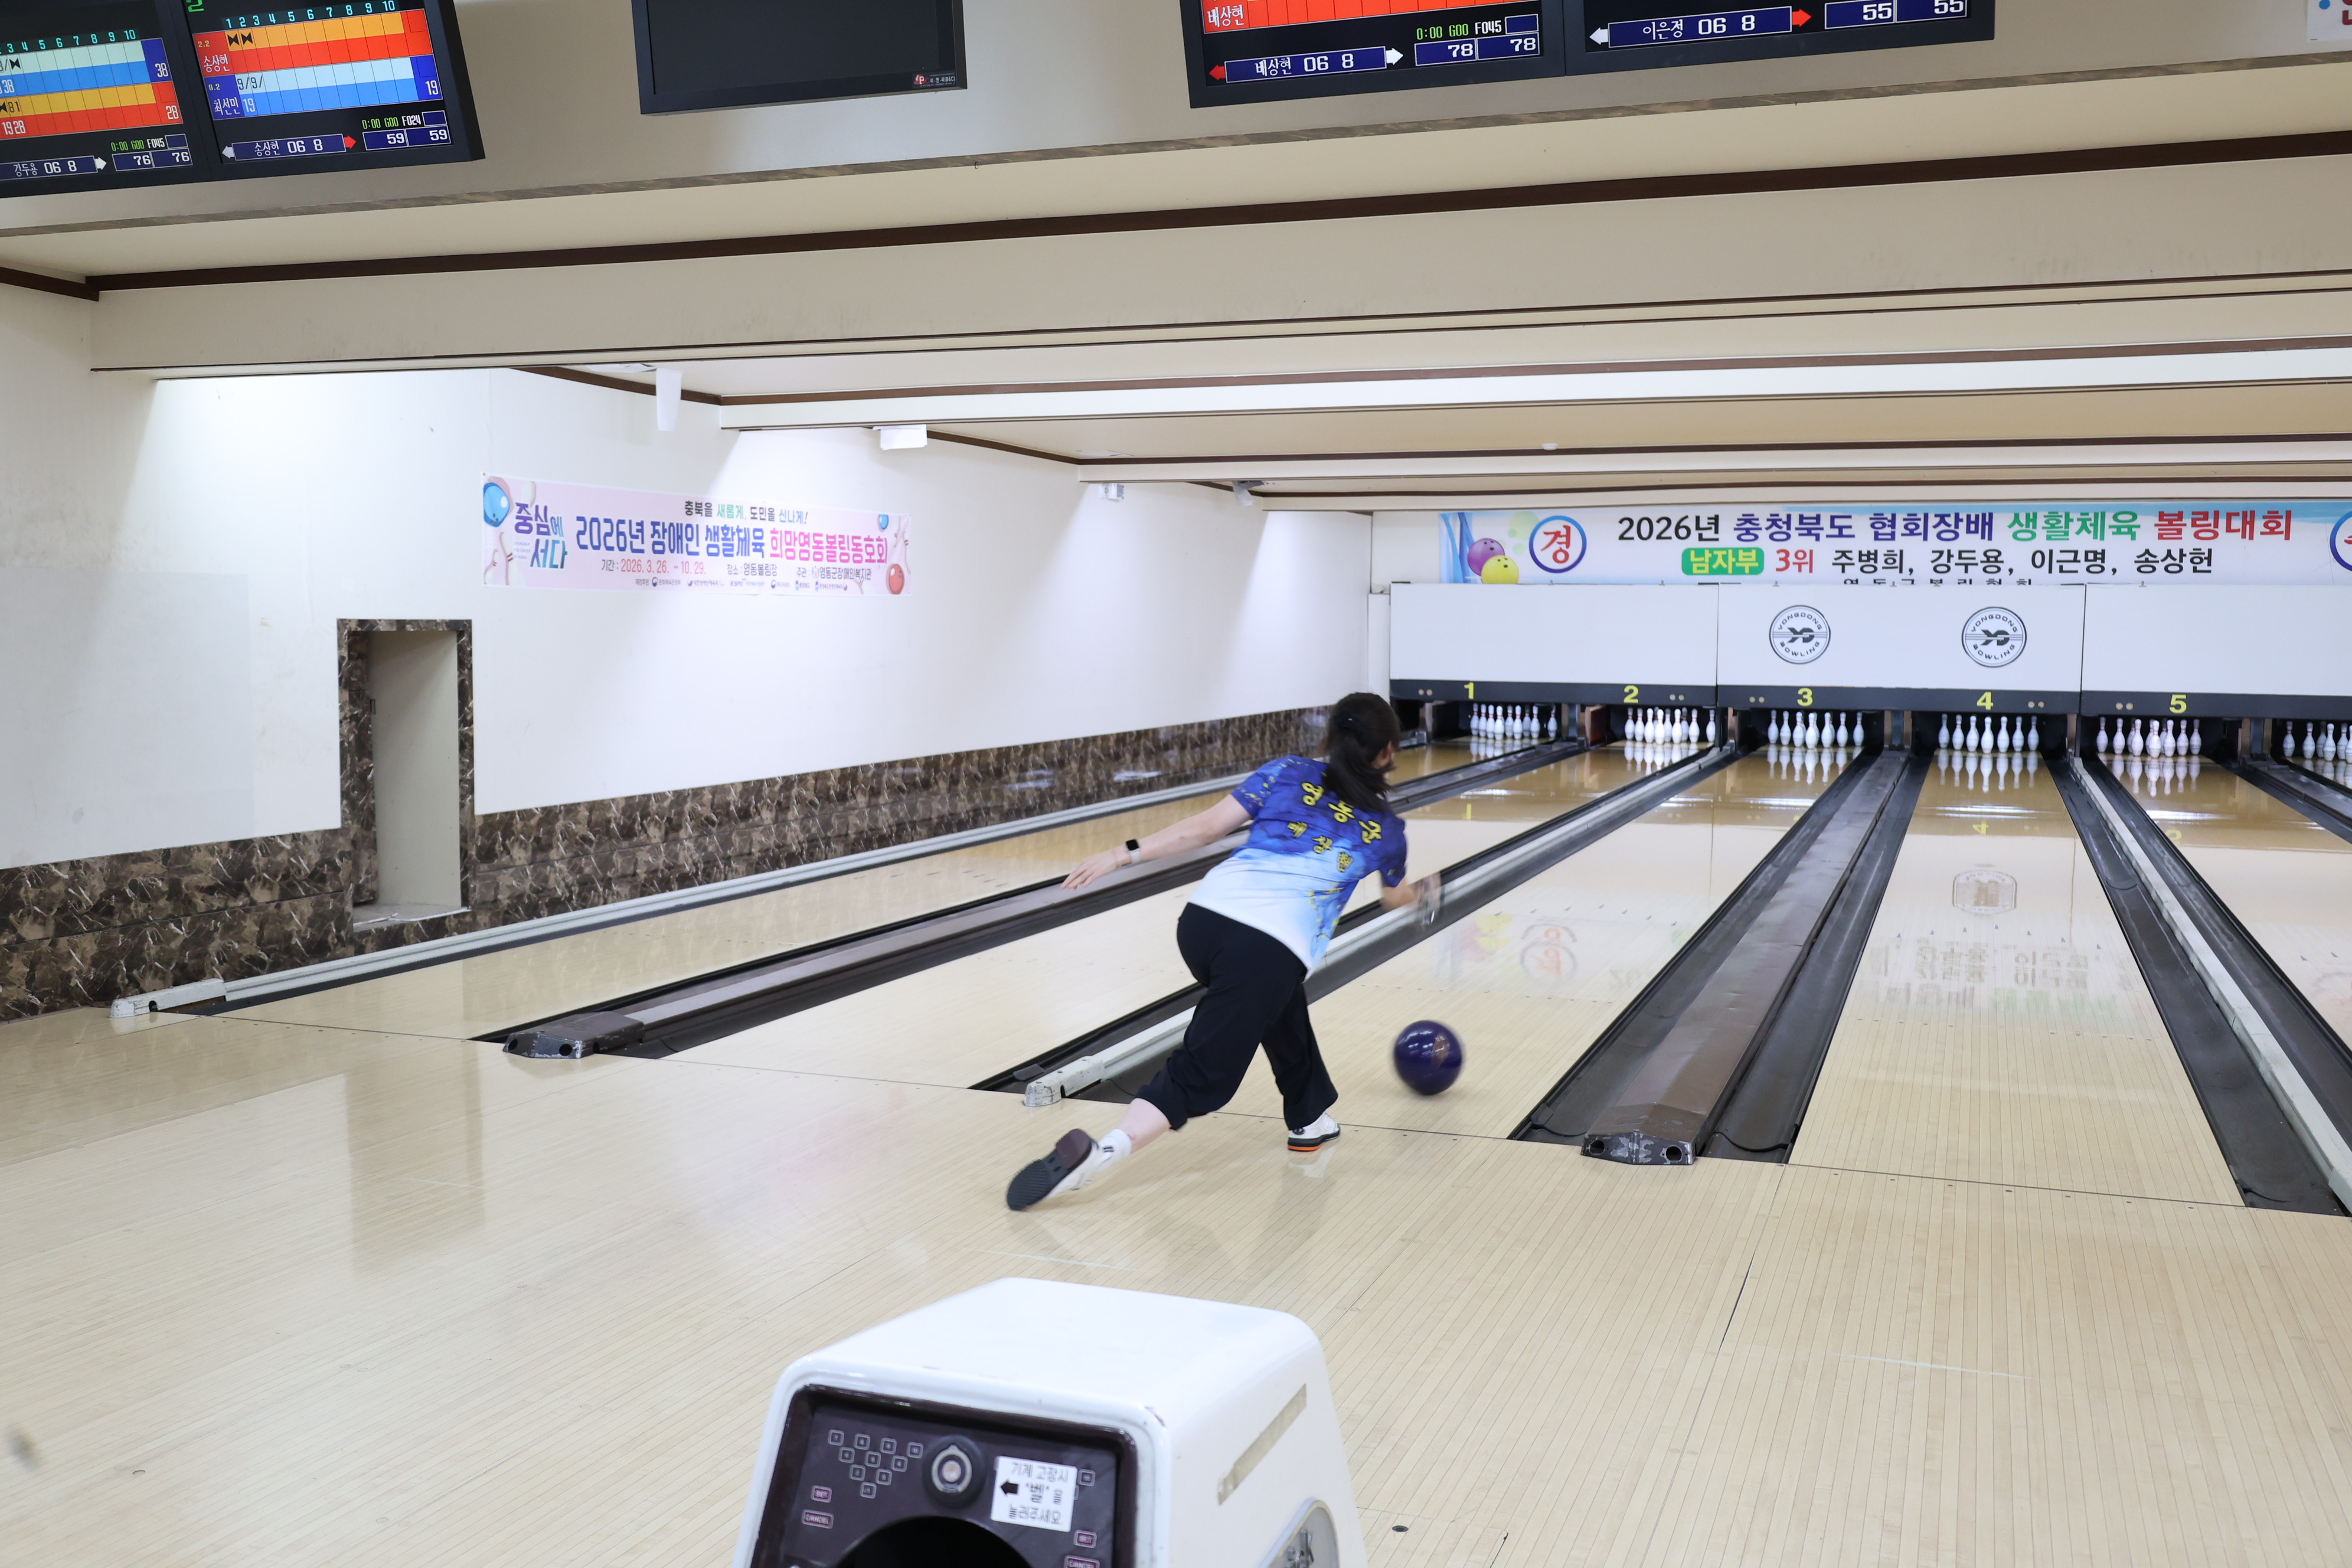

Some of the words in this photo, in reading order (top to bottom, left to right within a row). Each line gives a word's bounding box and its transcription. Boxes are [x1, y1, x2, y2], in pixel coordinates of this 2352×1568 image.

[226, 18, 231, 28] 1
[239, 17, 246, 27] 2
[253, 15, 260, 25] 3
[269, 14, 276, 24] 4
[288, 11, 295, 22] 5
[307, 9, 315, 19] 6
[326, 7, 333, 17] 7
[345, 5, 353, 15] 8
[365, 3, 373, 13] 9
[384, 1, 396, 11] 10
[1207, 5, 1244, 28] 배상현
[1863, 4, 1892, 21] 55
[1934, 0, 1964, 14] 55
[1416, 26, 1443, 40] 0:00
[1642, 19, 1683, 40] 이은정
[1742, 15, 1755, 31] 8
[7, 43, 14, 53] 3
[21, 41, 28, 51] 4
[38, 40, 45, 50] 5
[56, 38, 63, 48] 6
[73, 35, 79, 45] 7
[91, 34, 98, 44] 8
[108, 32, 115, 42] 9
[124, 30, 136, 40] 10
[1448, 43, 1474, 58] 78
[1510, 37, 1536, 52] 78
[155, 63, 168, 77] 38
[204, 54, 230, 73] 송상헌
[1255, 57, 1292, 77] 배상현
[1341, 53, 1354, 68] 8
[243, 98, 256, 112] 19
[425, 80, 439, 95] 19
[166, 106, 179, 120] 28
[213, 97, 241, 115] 최선민
[362, 118, 381, 129] 0:00
[387, 133, 405, 144] 59
[430, 129, 447, 141] 59
[254, 142, 280, 156] 송상헌
[313, 139, 323, 152] 8
[67, 160, 77, 172] 8
[133, 155, 151, 165] 76
[172, 152, 190, 163] 76
[514, 502, 564, 537] 중심에
[685, 500, 713, 518] 충북을
[750, 506, 775, 522] 도민을
[1618, 514, 1719, 541] 2026년
[1733, 513, 1856, 542] 충청북도
[1869, 512, 1994, 541] 협회장배
[2007, 510, 2141, 541] 생활체육
[2154, 509, 2291, 541] 볼링대회
[576, 515, 645, 554] 2026년
[650, 520, 700, 556] 장애인
[705, 524, 766, 558] 생활체육
[1540, 525, 1571, 564] 경
[530, 538, 568, 569] 서다
[1690, 548, 1759, 574] 남자부
[1775, 548, 1814, 574] 3위
[1832, 548, 1914, 576] 주병희,
[1930, 548, 2014, 576] 강두용,
[2031, 548, 2117, 576] 이근명,
[2134, 548, 2213, 574] 송상헌
[744, 563, 778, 576] 영동볼링장
[819, 567, 872, 580] 영동군장애인복지관
[1778, 612, 1822, 630] YONGDONG
[1971, 614, 2018, 633] YONGDONG
[1780, 641, 1820, 656] BOWLING
[1973, 643, 2015, 660] BOWLING
[1464, 682, 1475, 700] 1
[1623, 685, 1639, 703] 2
[1797, 688, 1813, 706] 3
[1976, 691, 1994, 710] 4
[2169, 694, 2188, 714] 5
[1011, 1462, 1033, 1478] 기계
